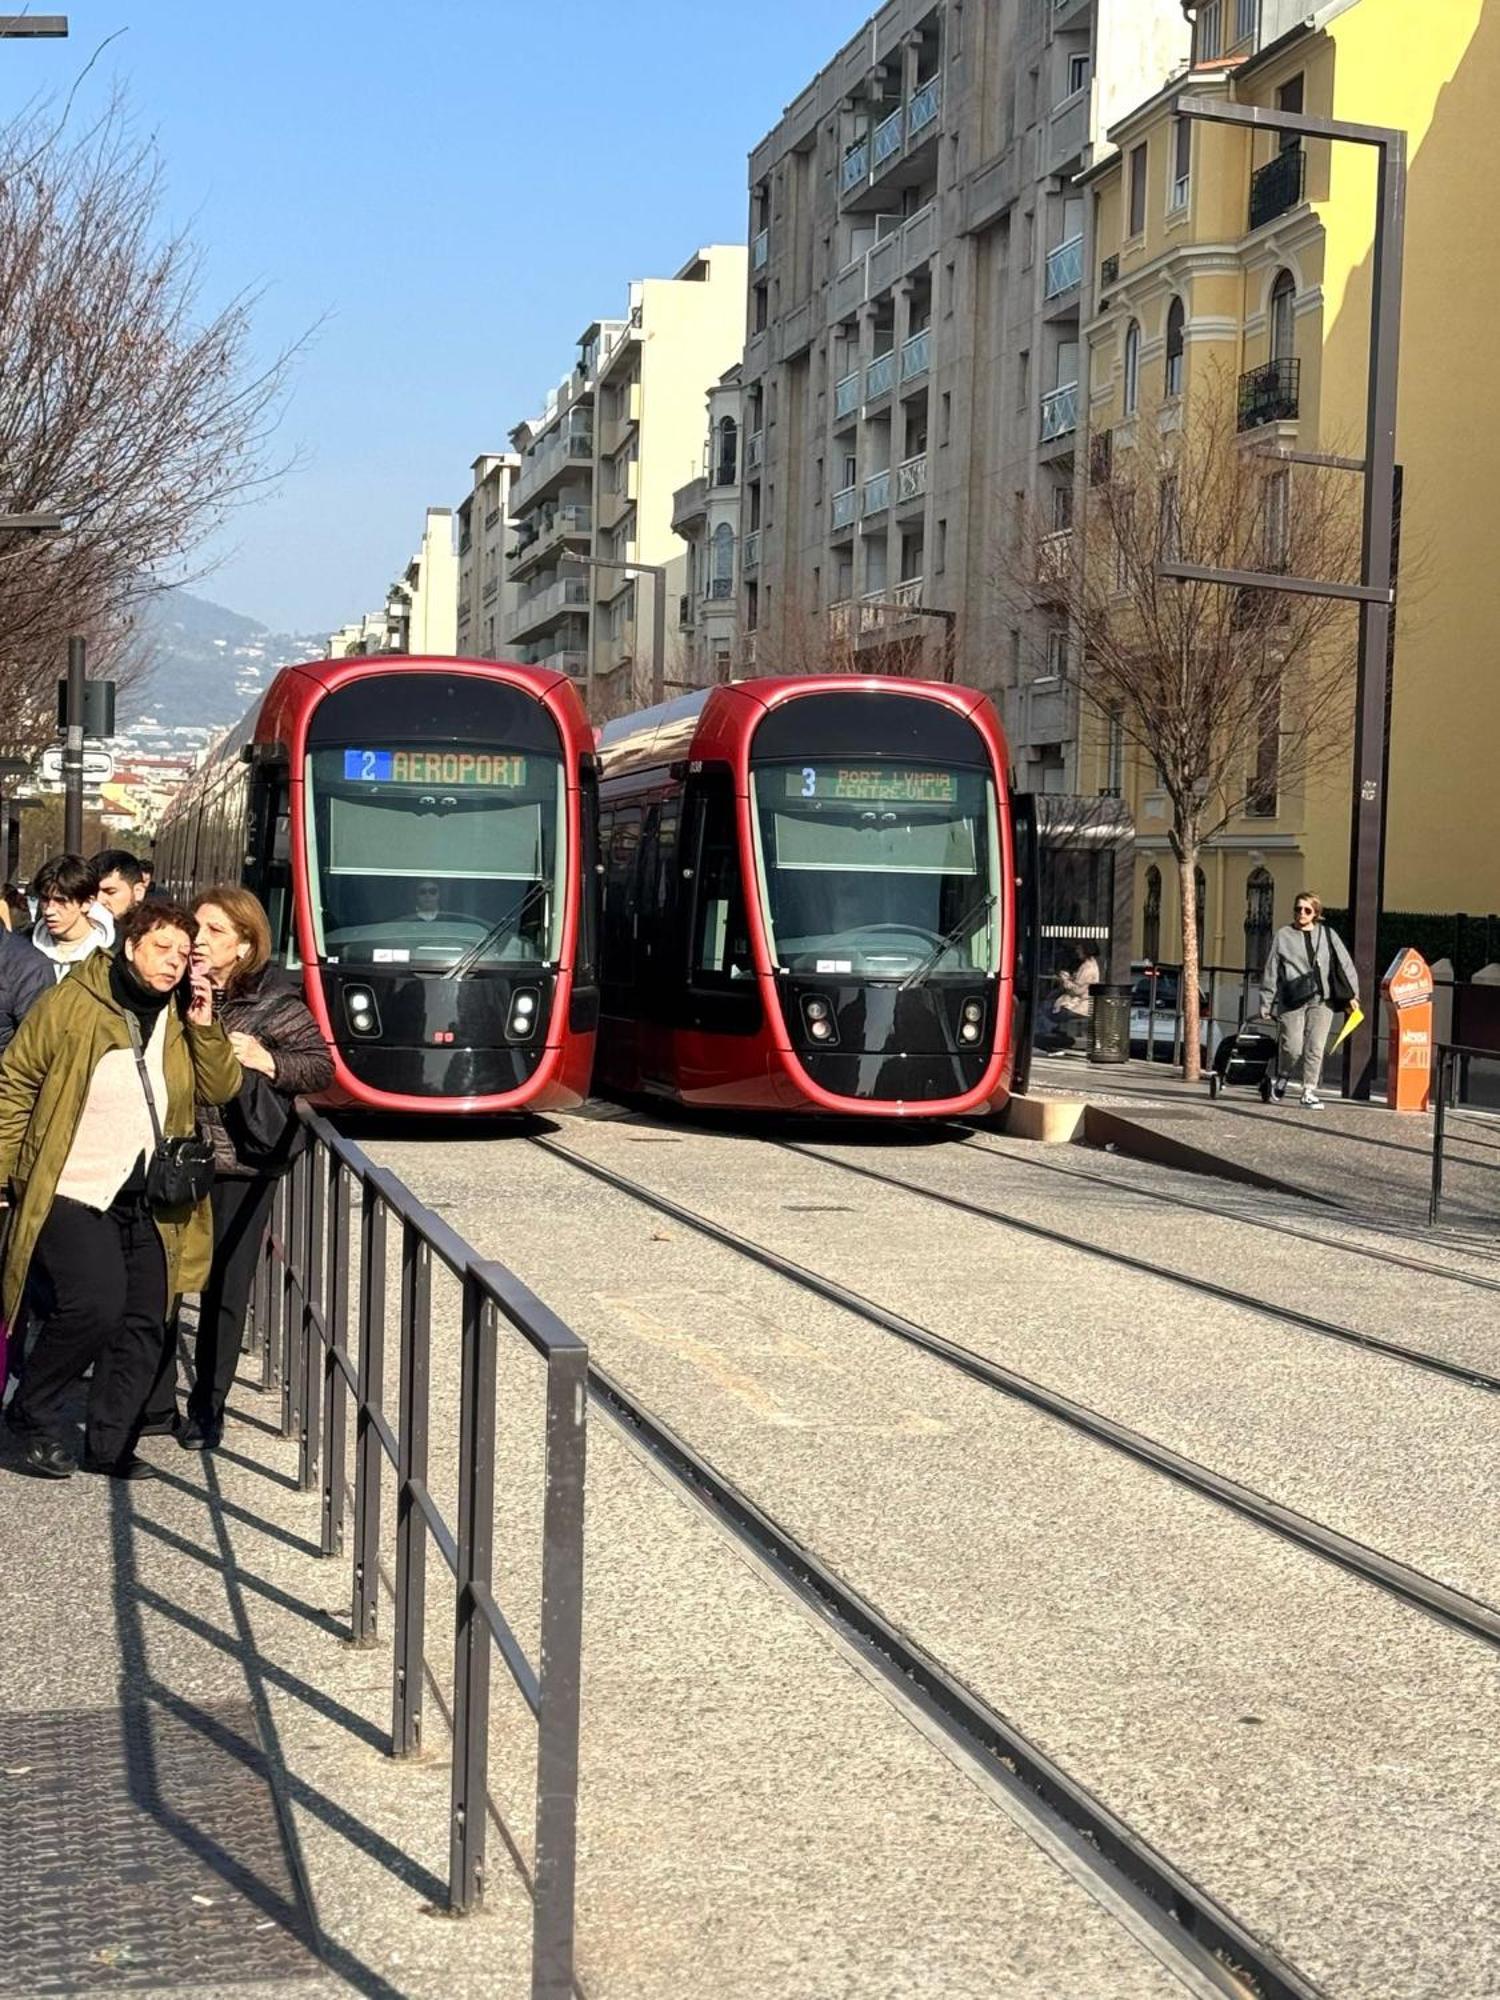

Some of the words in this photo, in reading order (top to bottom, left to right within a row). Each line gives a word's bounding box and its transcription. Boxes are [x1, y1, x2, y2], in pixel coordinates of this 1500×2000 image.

[361, 751, 376, 780] 2
[393, 752, 525, 786] AEROPORT
[894, 772, 950, 787] LYMPIA
[801, 767, 816, 797] 3
[835, 784, 953, 801] CENTRE-VILLE
